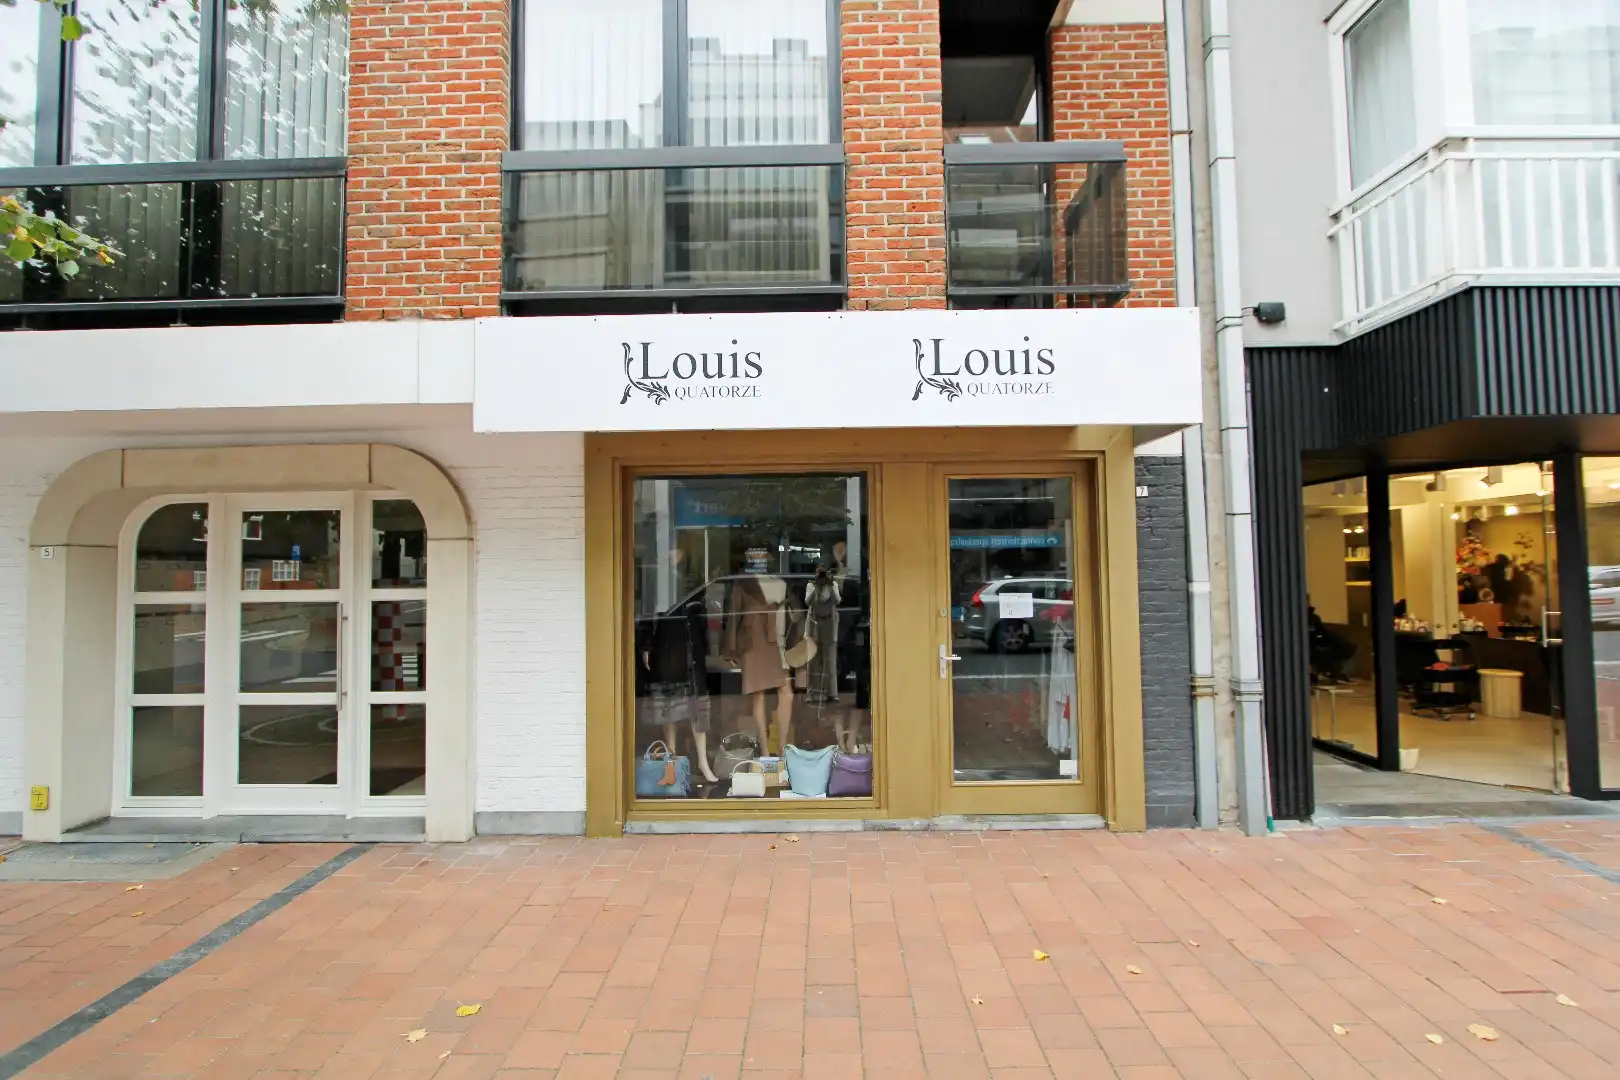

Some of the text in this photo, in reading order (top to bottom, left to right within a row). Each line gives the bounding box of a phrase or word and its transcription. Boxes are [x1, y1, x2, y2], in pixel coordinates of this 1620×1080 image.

[638, 339, 763, 379] Louis
[929, 336, 1056, 376] Louis
[674, 385, 763, 400] QUATORZE
[967, 382, 1055, 397] QUATORZE
[44, 548, 50, 557] 5
